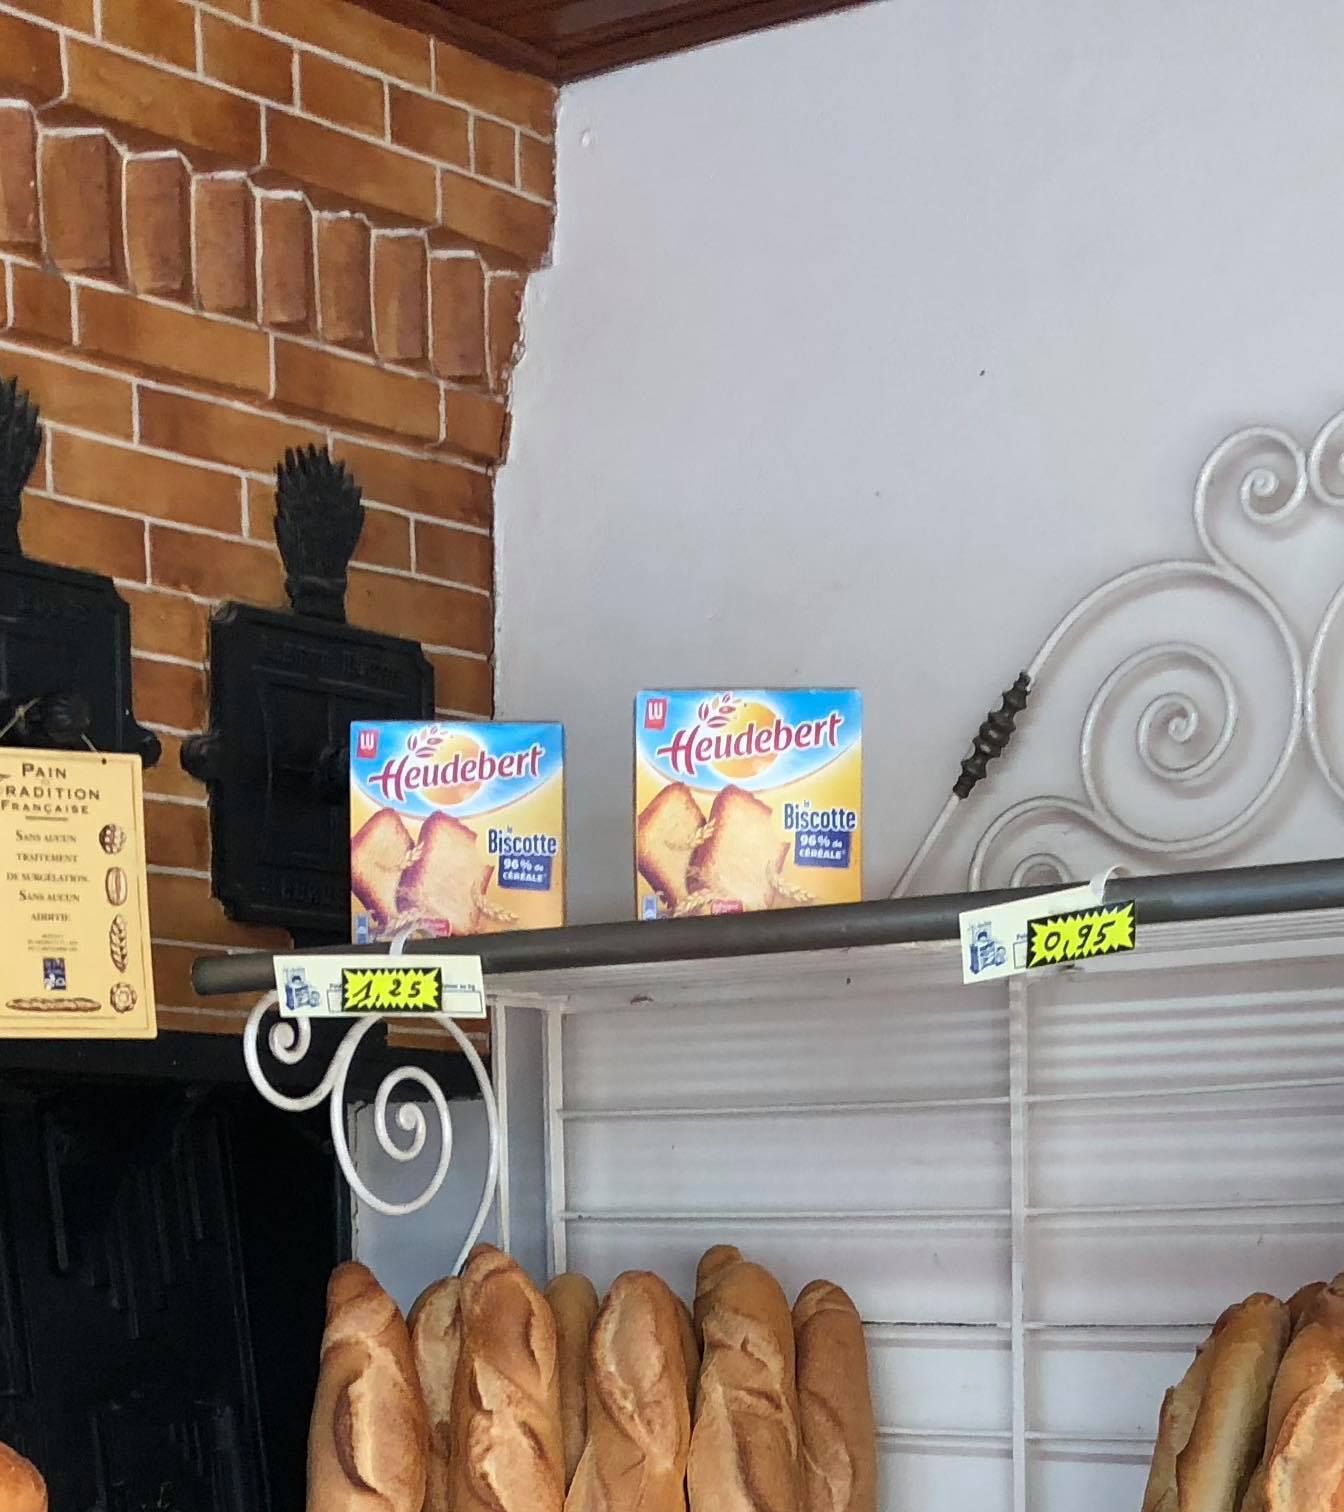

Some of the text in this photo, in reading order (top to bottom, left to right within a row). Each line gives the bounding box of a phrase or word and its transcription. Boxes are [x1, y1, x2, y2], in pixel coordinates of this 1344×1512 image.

[649, 701, 663, 720] LU
[360, 731, 375, 751] LU
[656, 713, 842, 775] Heudebert
[22, 762, 67, 779] PAIN
[369, 744, 545, 801] Heudebert
[0, 800, 89, 815] FRANÇAISE
[784, 803, 855, 830] Biscotte
[16, 829, 77, 843] SANS AUCUN
[488, 829, 556, 855] Biscotte
[19, 890, 80, 903] SANS AUCUN
[1044, 920, 1116, 951] 0,95
[352, 978, 422, 1004] 1,25
